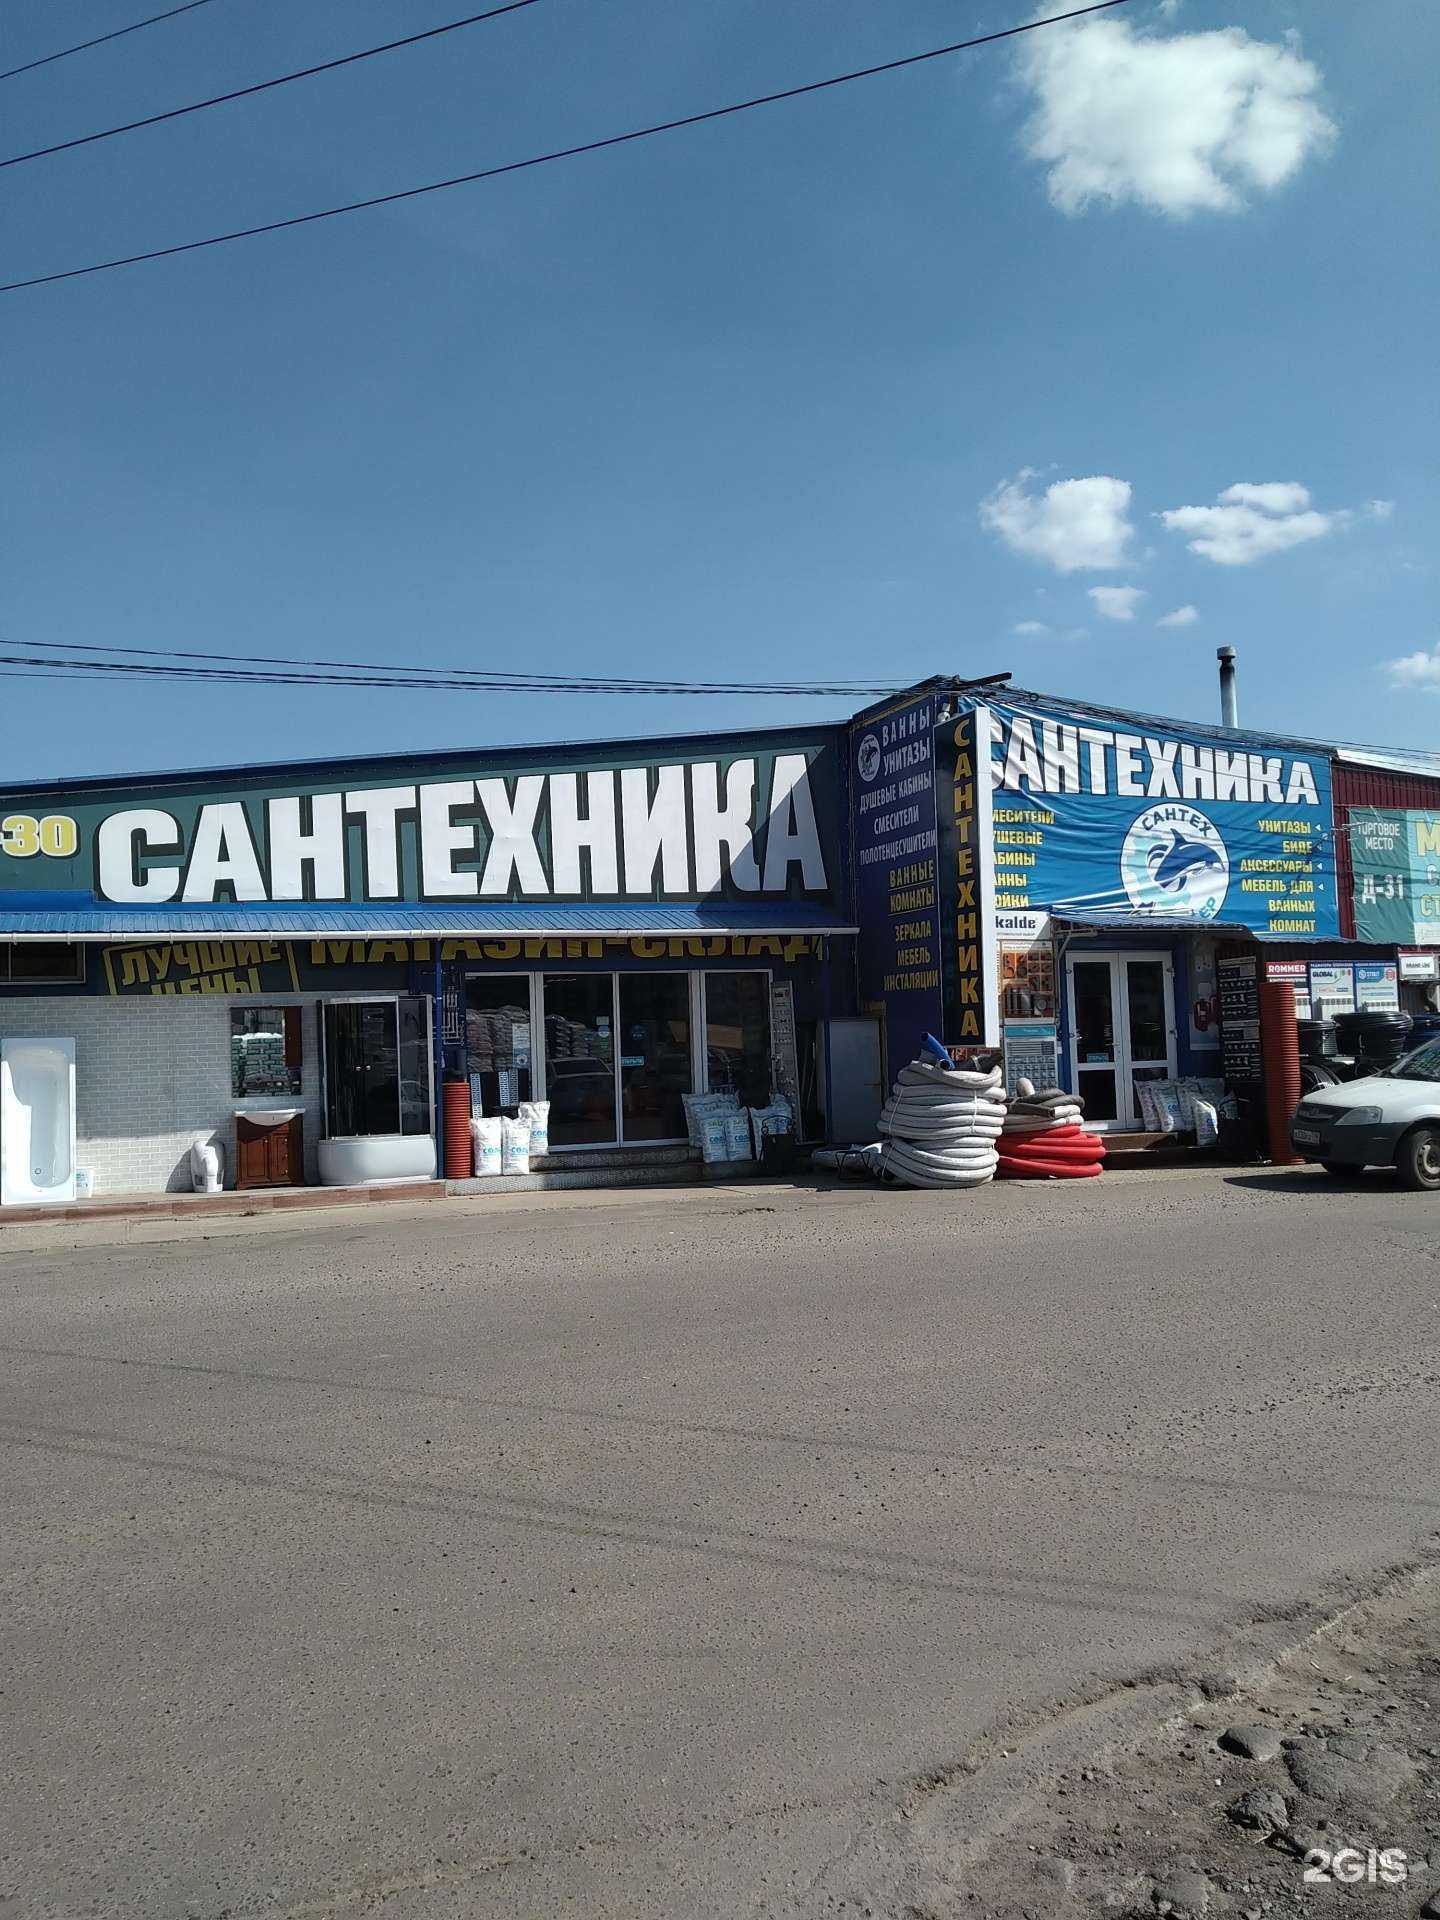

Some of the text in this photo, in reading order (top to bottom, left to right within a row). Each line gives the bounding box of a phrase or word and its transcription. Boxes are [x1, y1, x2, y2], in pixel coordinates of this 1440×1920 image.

[882, 705, 931, 748] ВАННЫ
[883, 737, 931, 776] УНИТАЗЫ
[860, 770, 933, 815] ДУШЕВЫЕ КАБИНЫ
[98, 753, 829, 904] САНТЕХНИКА
[873, 804, 920, 835] СМЕСИТЕЛИ
[1141, 807, 1213, 837] САНТЕХ
[1257, 820, 1312, 834] УНИТАЗЫ
[1282, 840, 1313, 855] БИДЕ
[1365, 837, 1394, 850] МЕСТО
[889, 859, 934, 888] ВАННЫЕ
[953, 718, 979, 1037] САНТЕХНИКА
[1240, 860, 1313, 873] АКСЕССУАРЫ
[1242, 879, 1314, 894] МЕБЕЛЬ ДЛЯ
[1362, 874, 1404, 904] Д-31
[889, 886, 935, 913] КОМНАТЫ
[994, 892, 1029, 907] ОЙКИ
[1268, 900, 1316, 912] ВАННЫХ
[894, 920, 932, 942] ЗЕРКАЛА
[995, 915, 1036, 929] kalde
[1269, 919, 1316, 932] КОМНАТ
[121, 941, 282, 986] ЛУЧШИЕ
[897, 946, 931, 967] МЕБЕЛЬ
[1268, 964, 1306, 973] ROMMER
[883, 969, 939, 992] ИНСТАЛЯЦИИ
